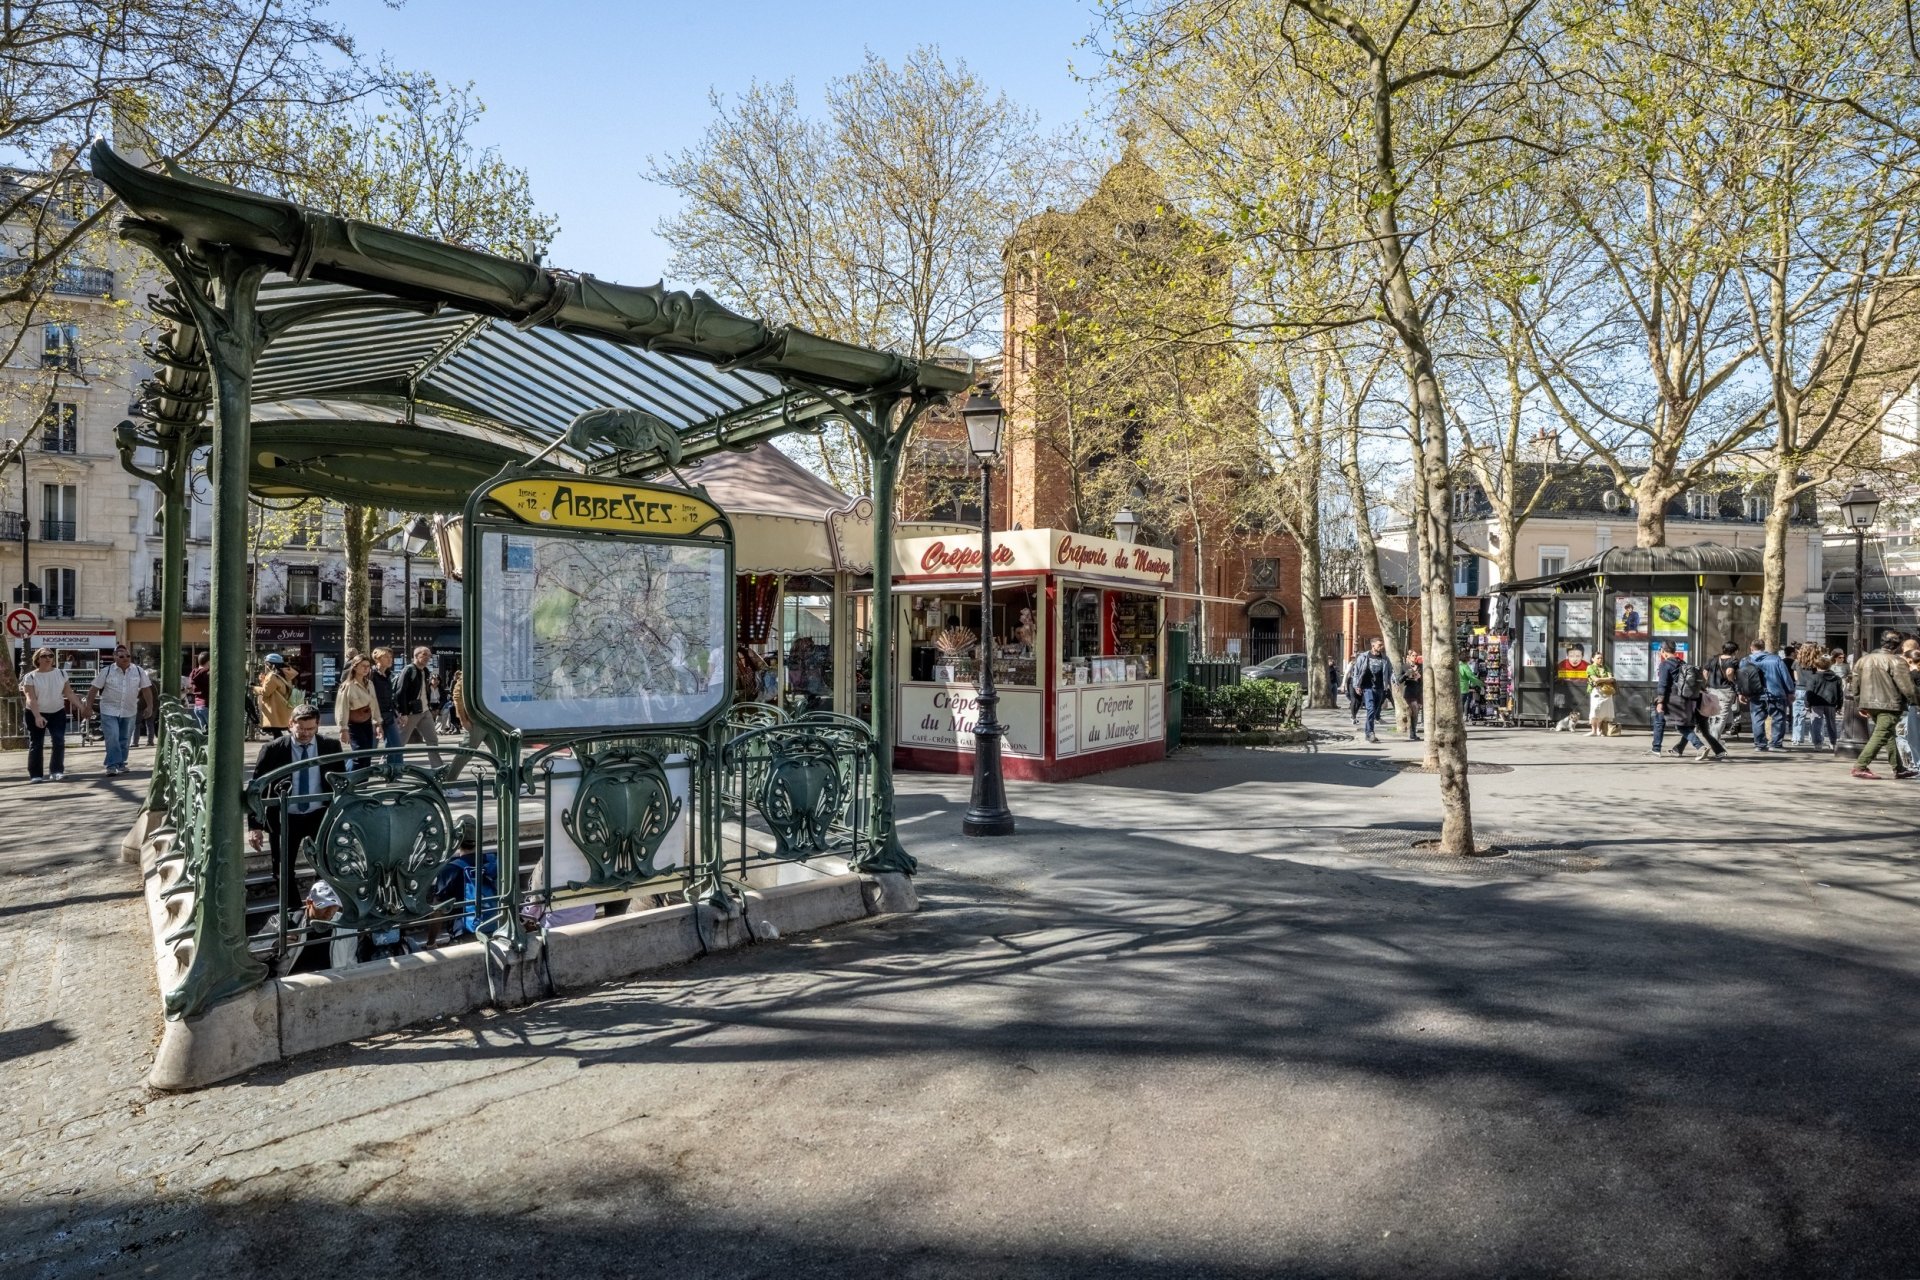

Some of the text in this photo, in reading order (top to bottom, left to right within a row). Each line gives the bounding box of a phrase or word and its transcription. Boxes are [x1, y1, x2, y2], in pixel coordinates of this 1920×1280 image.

[526, 498, 537, 510] 12
[551, 485, 673, 524] ABBESSES
[689, 512, 698, 523] 12
[920, 541, 1014, 574] Crêpeie
[1057, 534, 1171, 582] Crêperie du Manège
[1709, 595, 1761, 606] ICON
[277, 629, 305, 640] Sylvia
[933, 692, 980, 714] Crêpe
[1096, 695, 1134, 717] Crêperie
[921, 714, 1011, 736] du Mae
[1088, 721, 1140, 743] du Manège
[932, 736, 956, 744] CRÊPES
[1001, 742, 1028, 751] OISSONS
